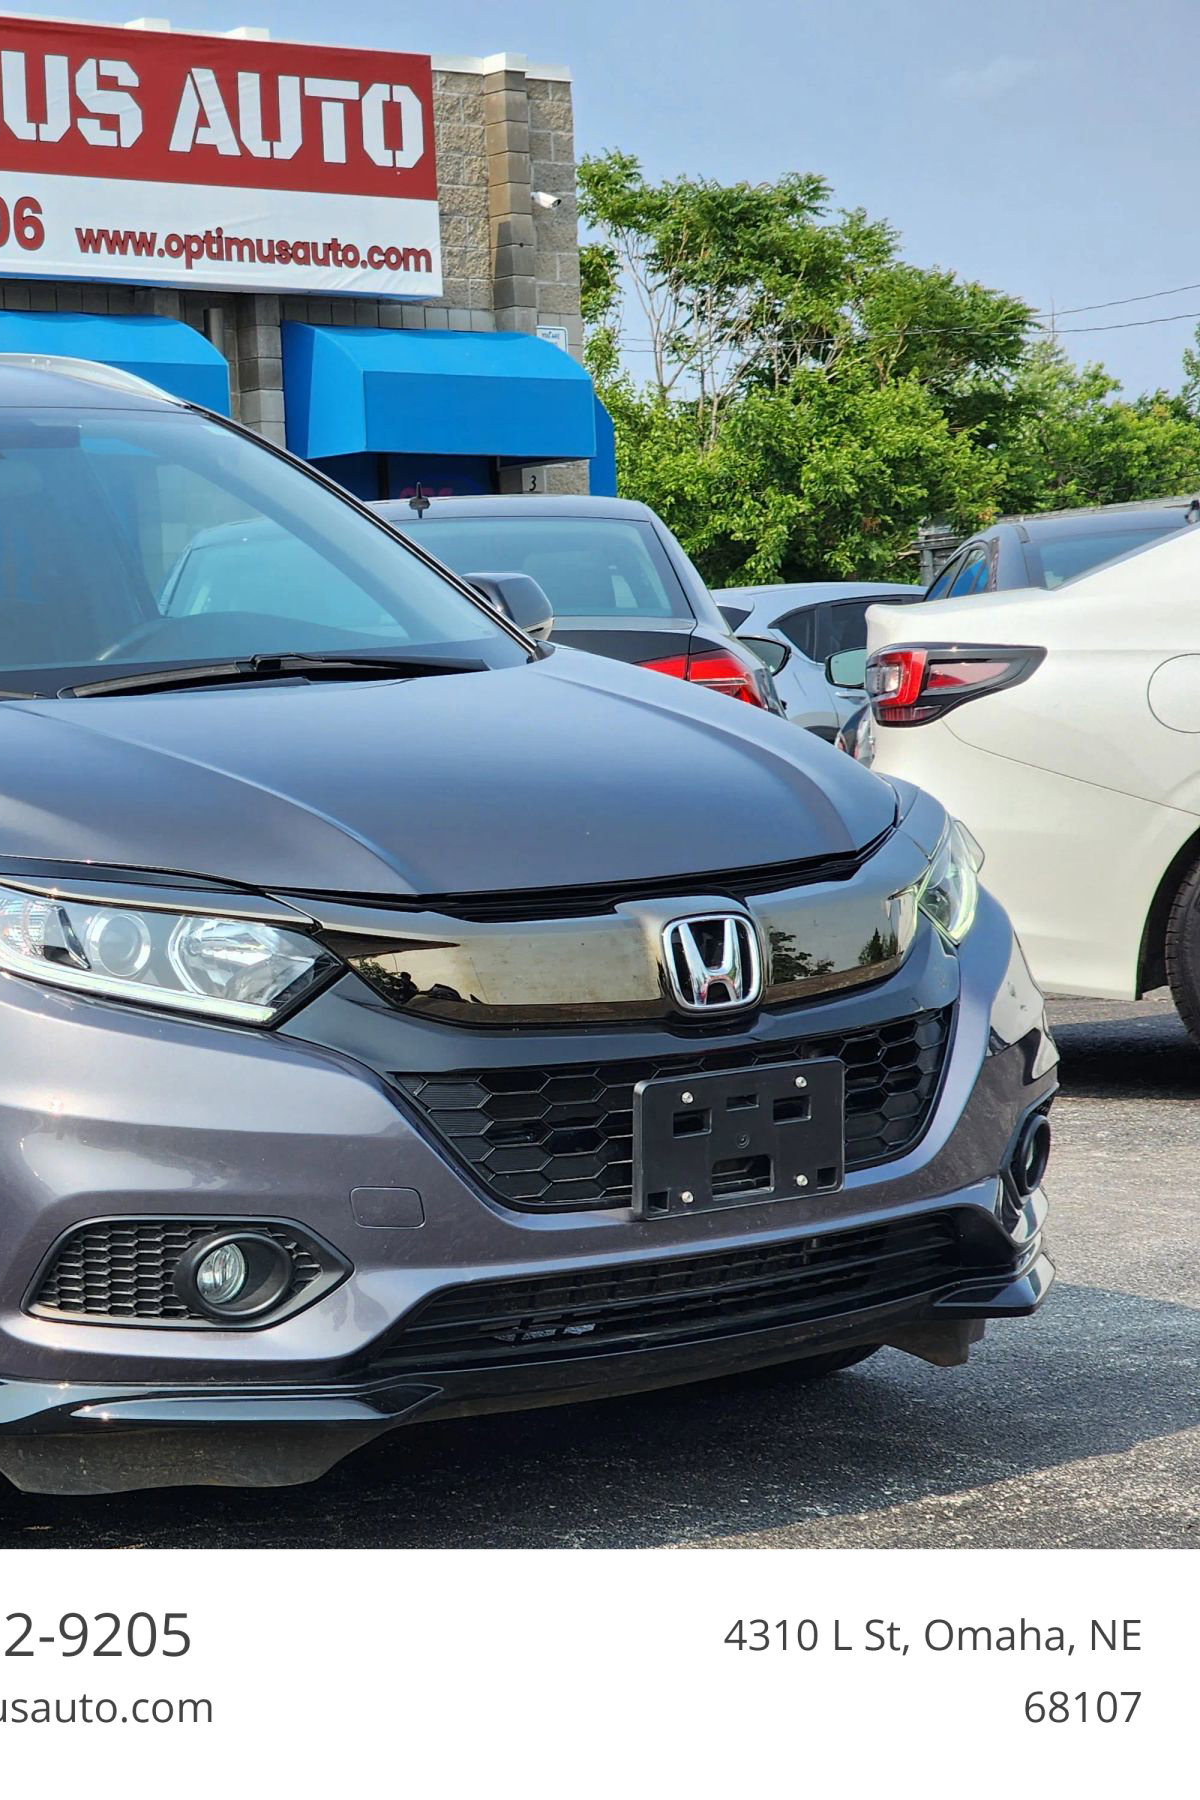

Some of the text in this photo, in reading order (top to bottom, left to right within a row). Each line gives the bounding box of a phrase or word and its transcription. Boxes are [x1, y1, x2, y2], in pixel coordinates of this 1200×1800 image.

[168, 67, 424, 169] AUTO
[76, 226, 432, 273] www.optimusauto.com
[529, 475, 537, 491] 3
